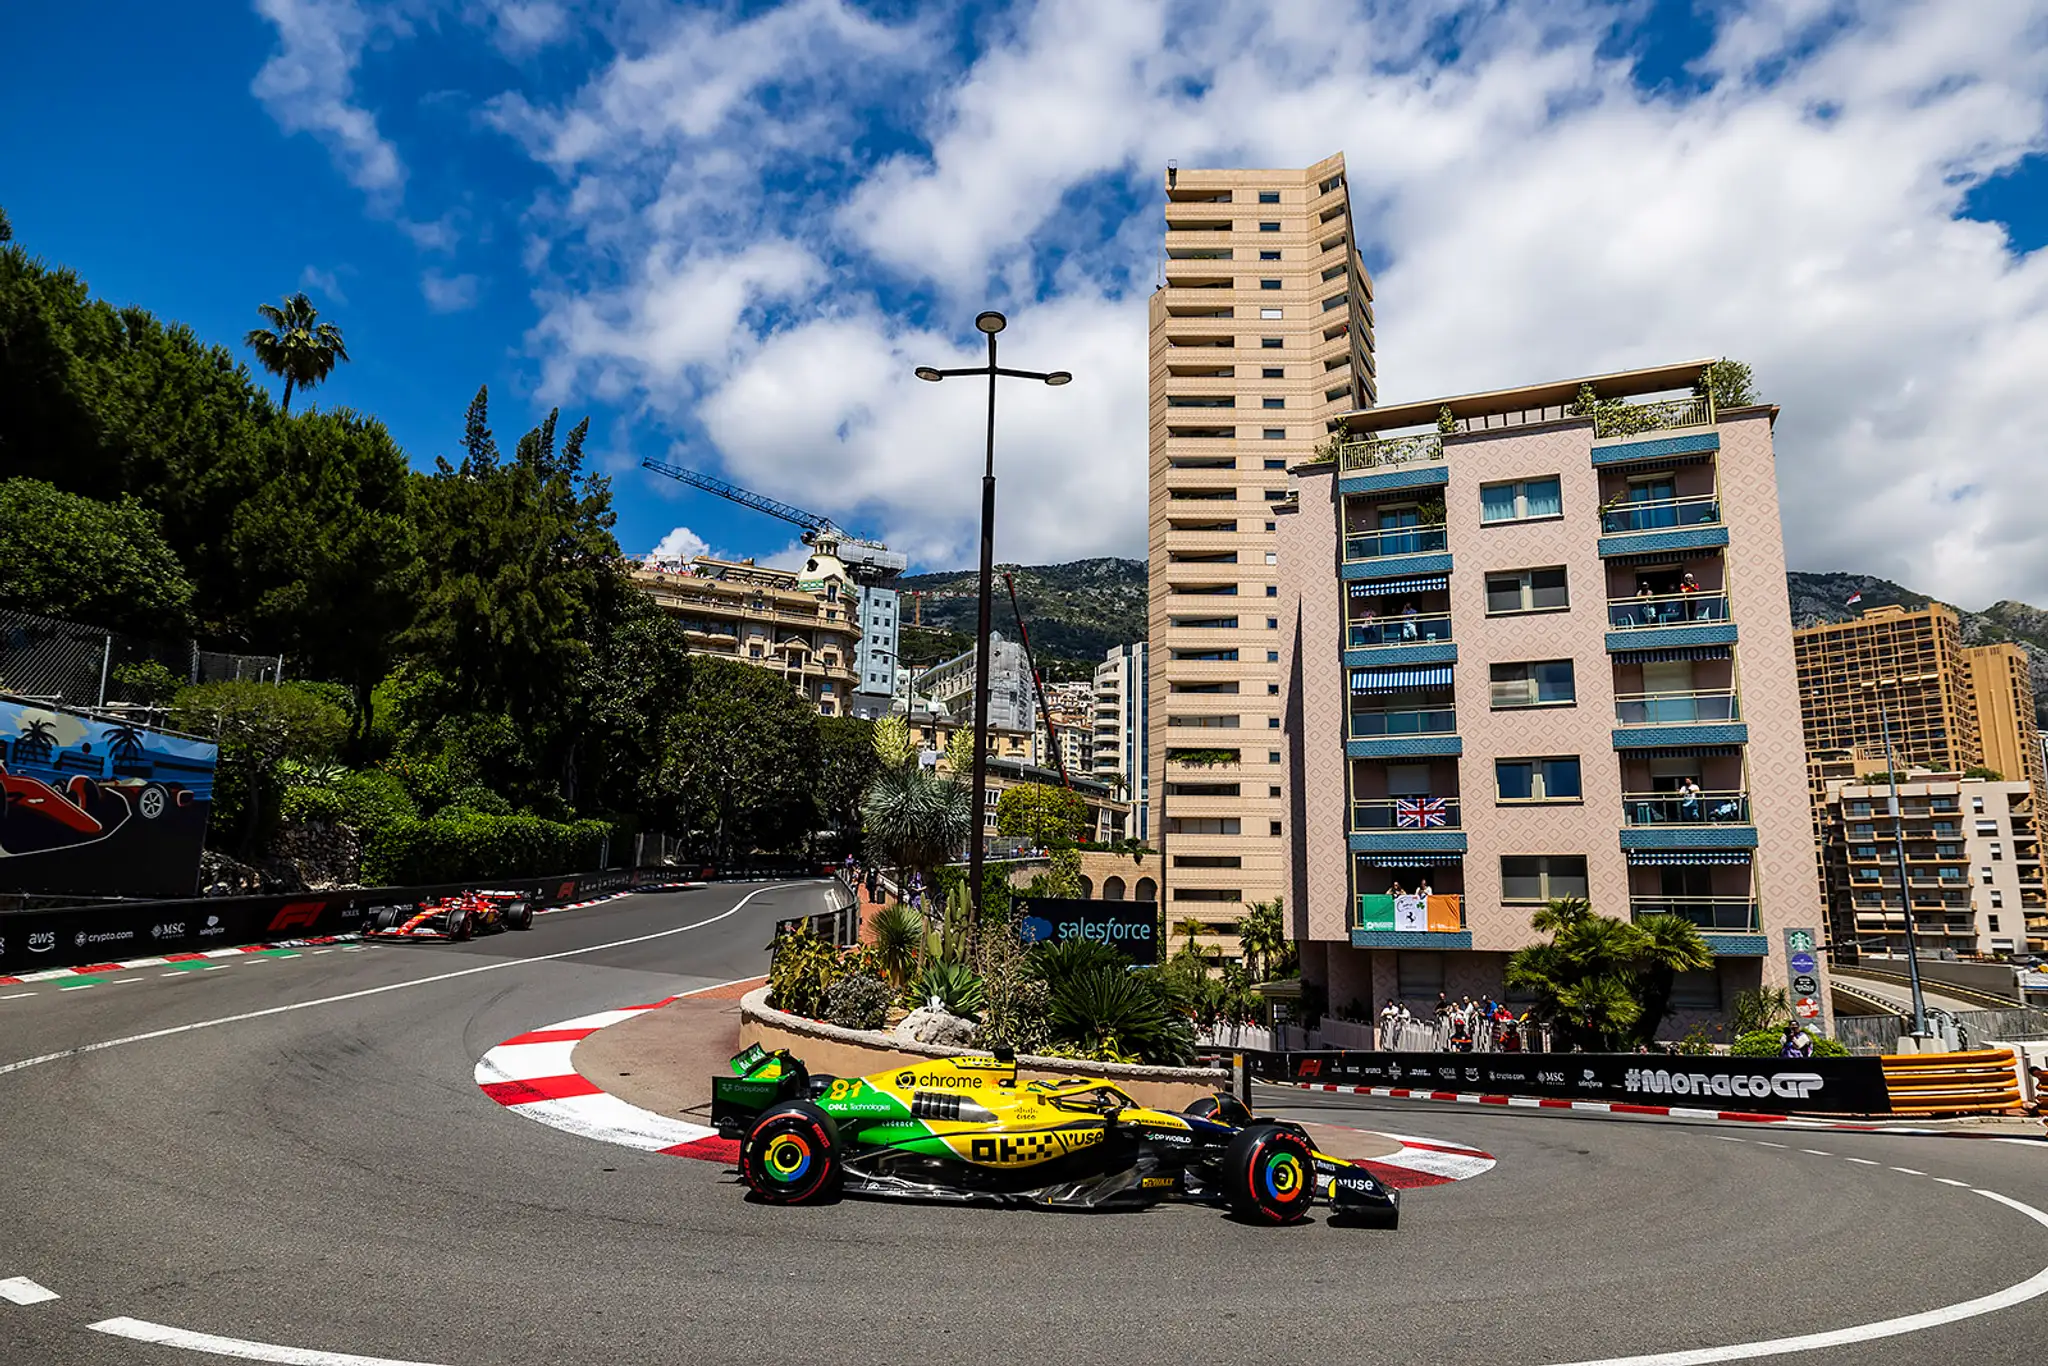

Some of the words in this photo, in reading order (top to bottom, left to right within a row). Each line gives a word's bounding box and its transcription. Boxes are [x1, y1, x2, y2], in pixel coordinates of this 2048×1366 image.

[267, 902, 327, 931] F1
[162, 922, 186, 935] MSC
[1058, 916, 1151, 945] salesforce
[28, 931, 55, 945] aws
[88, 931, 134, 943] crypto.com
[1298, 1060, 1322, 1077] F1
[919, 1072, 982, 1089] chrome
[1545, 1072, 1564, 1082] MSC
[734, 1084, 770, 1094] Dropbox
[829, 1078, 863, 1101] 81
[827, 1103, 848, 1111] DELL
[849, 1103, 891, 1112] Technologies
[1165, 1134, 1192, 1144] WORLD
